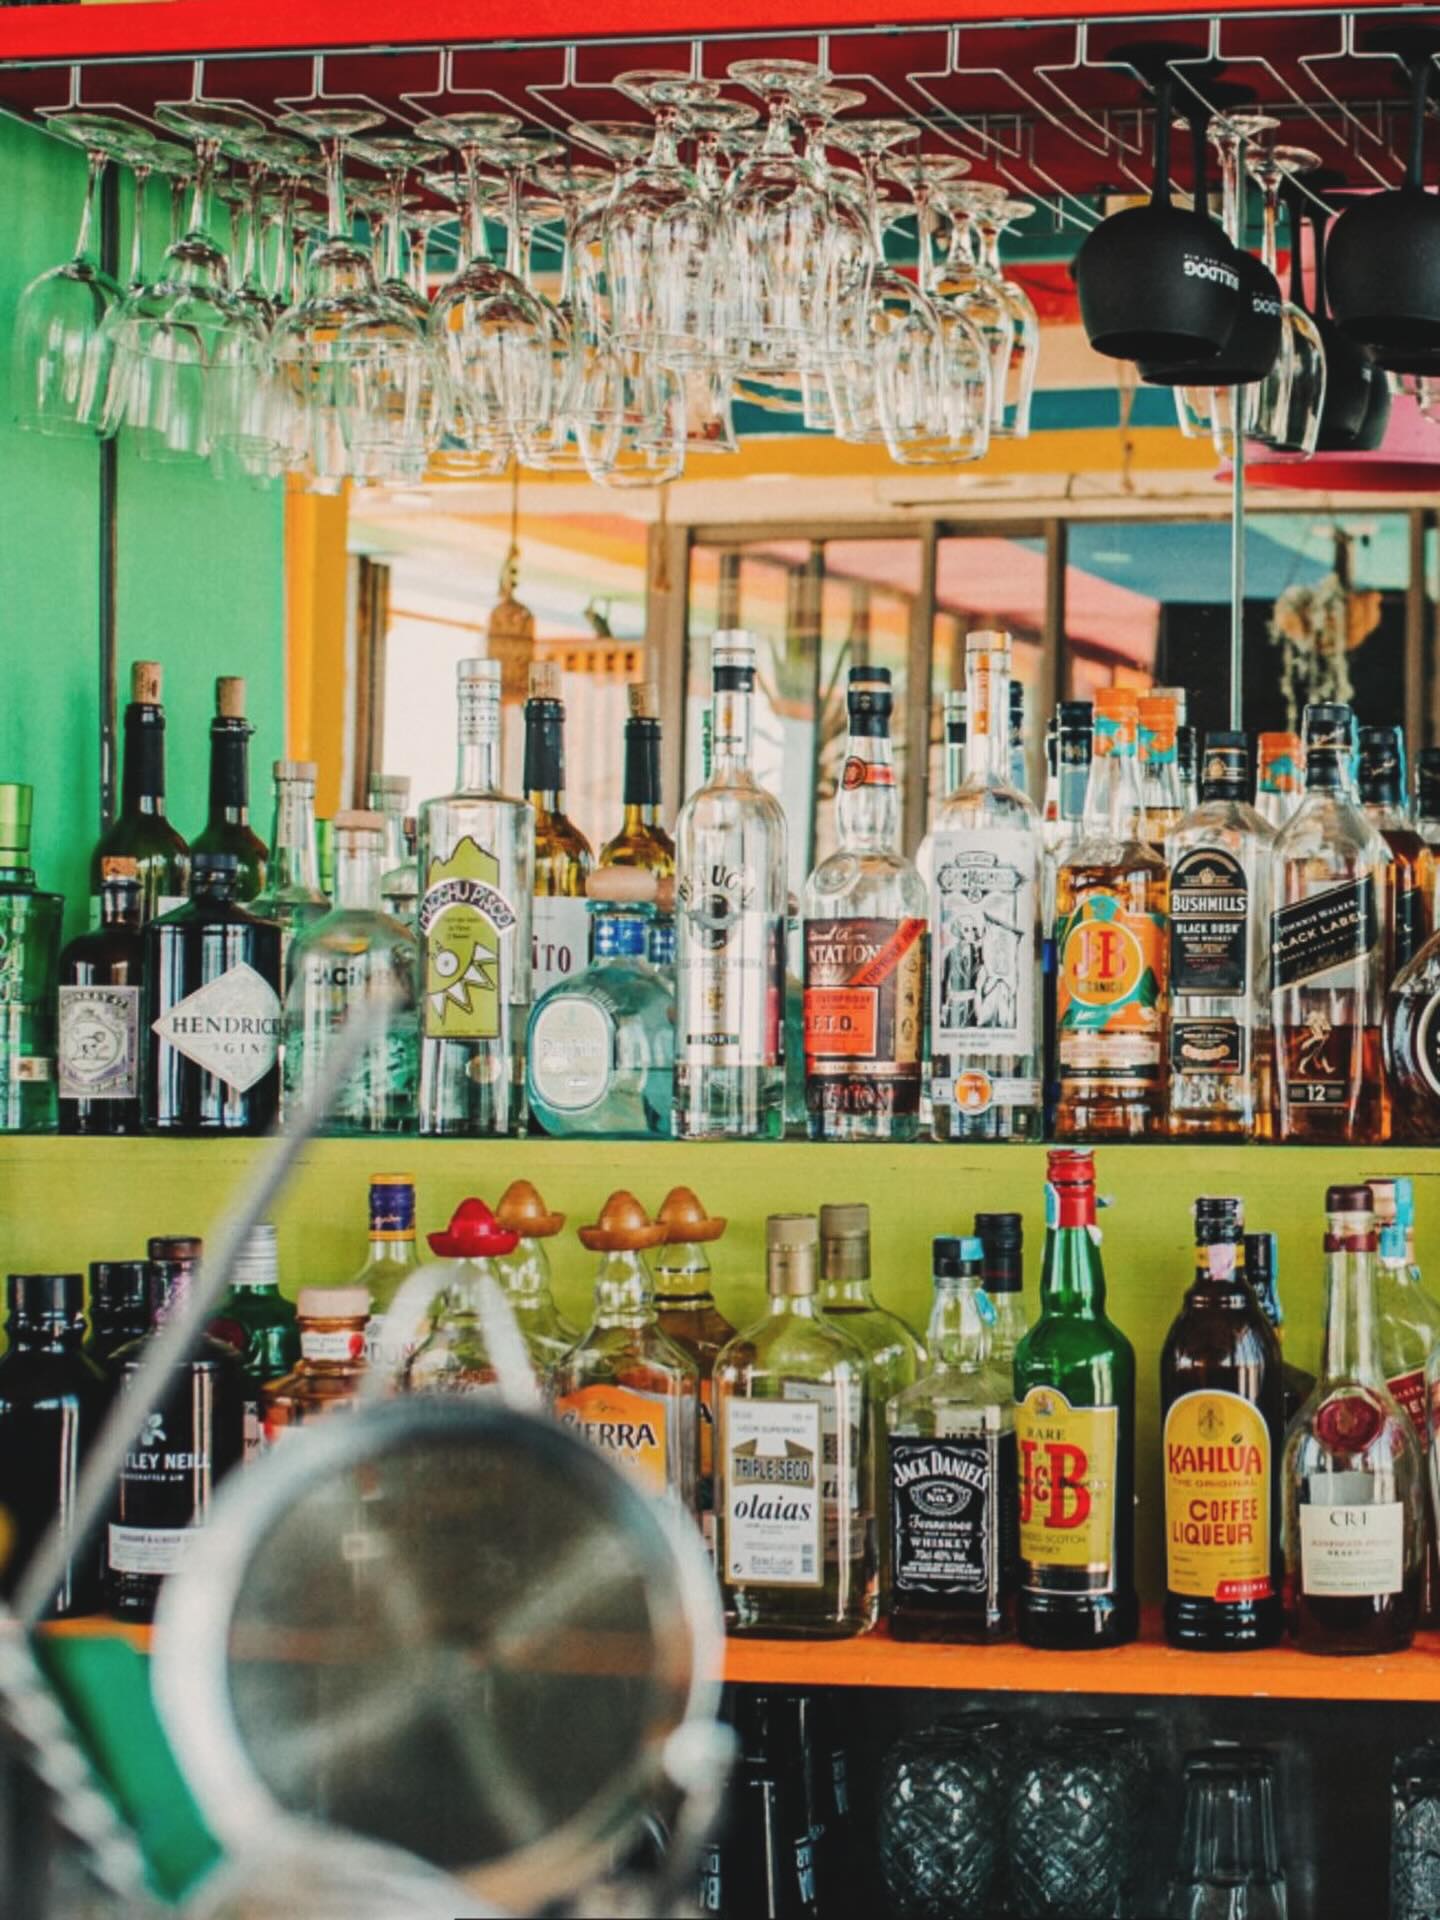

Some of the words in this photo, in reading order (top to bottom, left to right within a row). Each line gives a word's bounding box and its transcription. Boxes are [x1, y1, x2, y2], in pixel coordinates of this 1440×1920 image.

[1172, 895, 1247, 912] BUSHMILLS
[1306, 1084, 1326, 1102] 12
[734, 1493, 812, 1520] olaias
[1188, 1500, 1259, 1522] COFFEE
[1172, 1521, 1253, 1546] LIQUEUR
